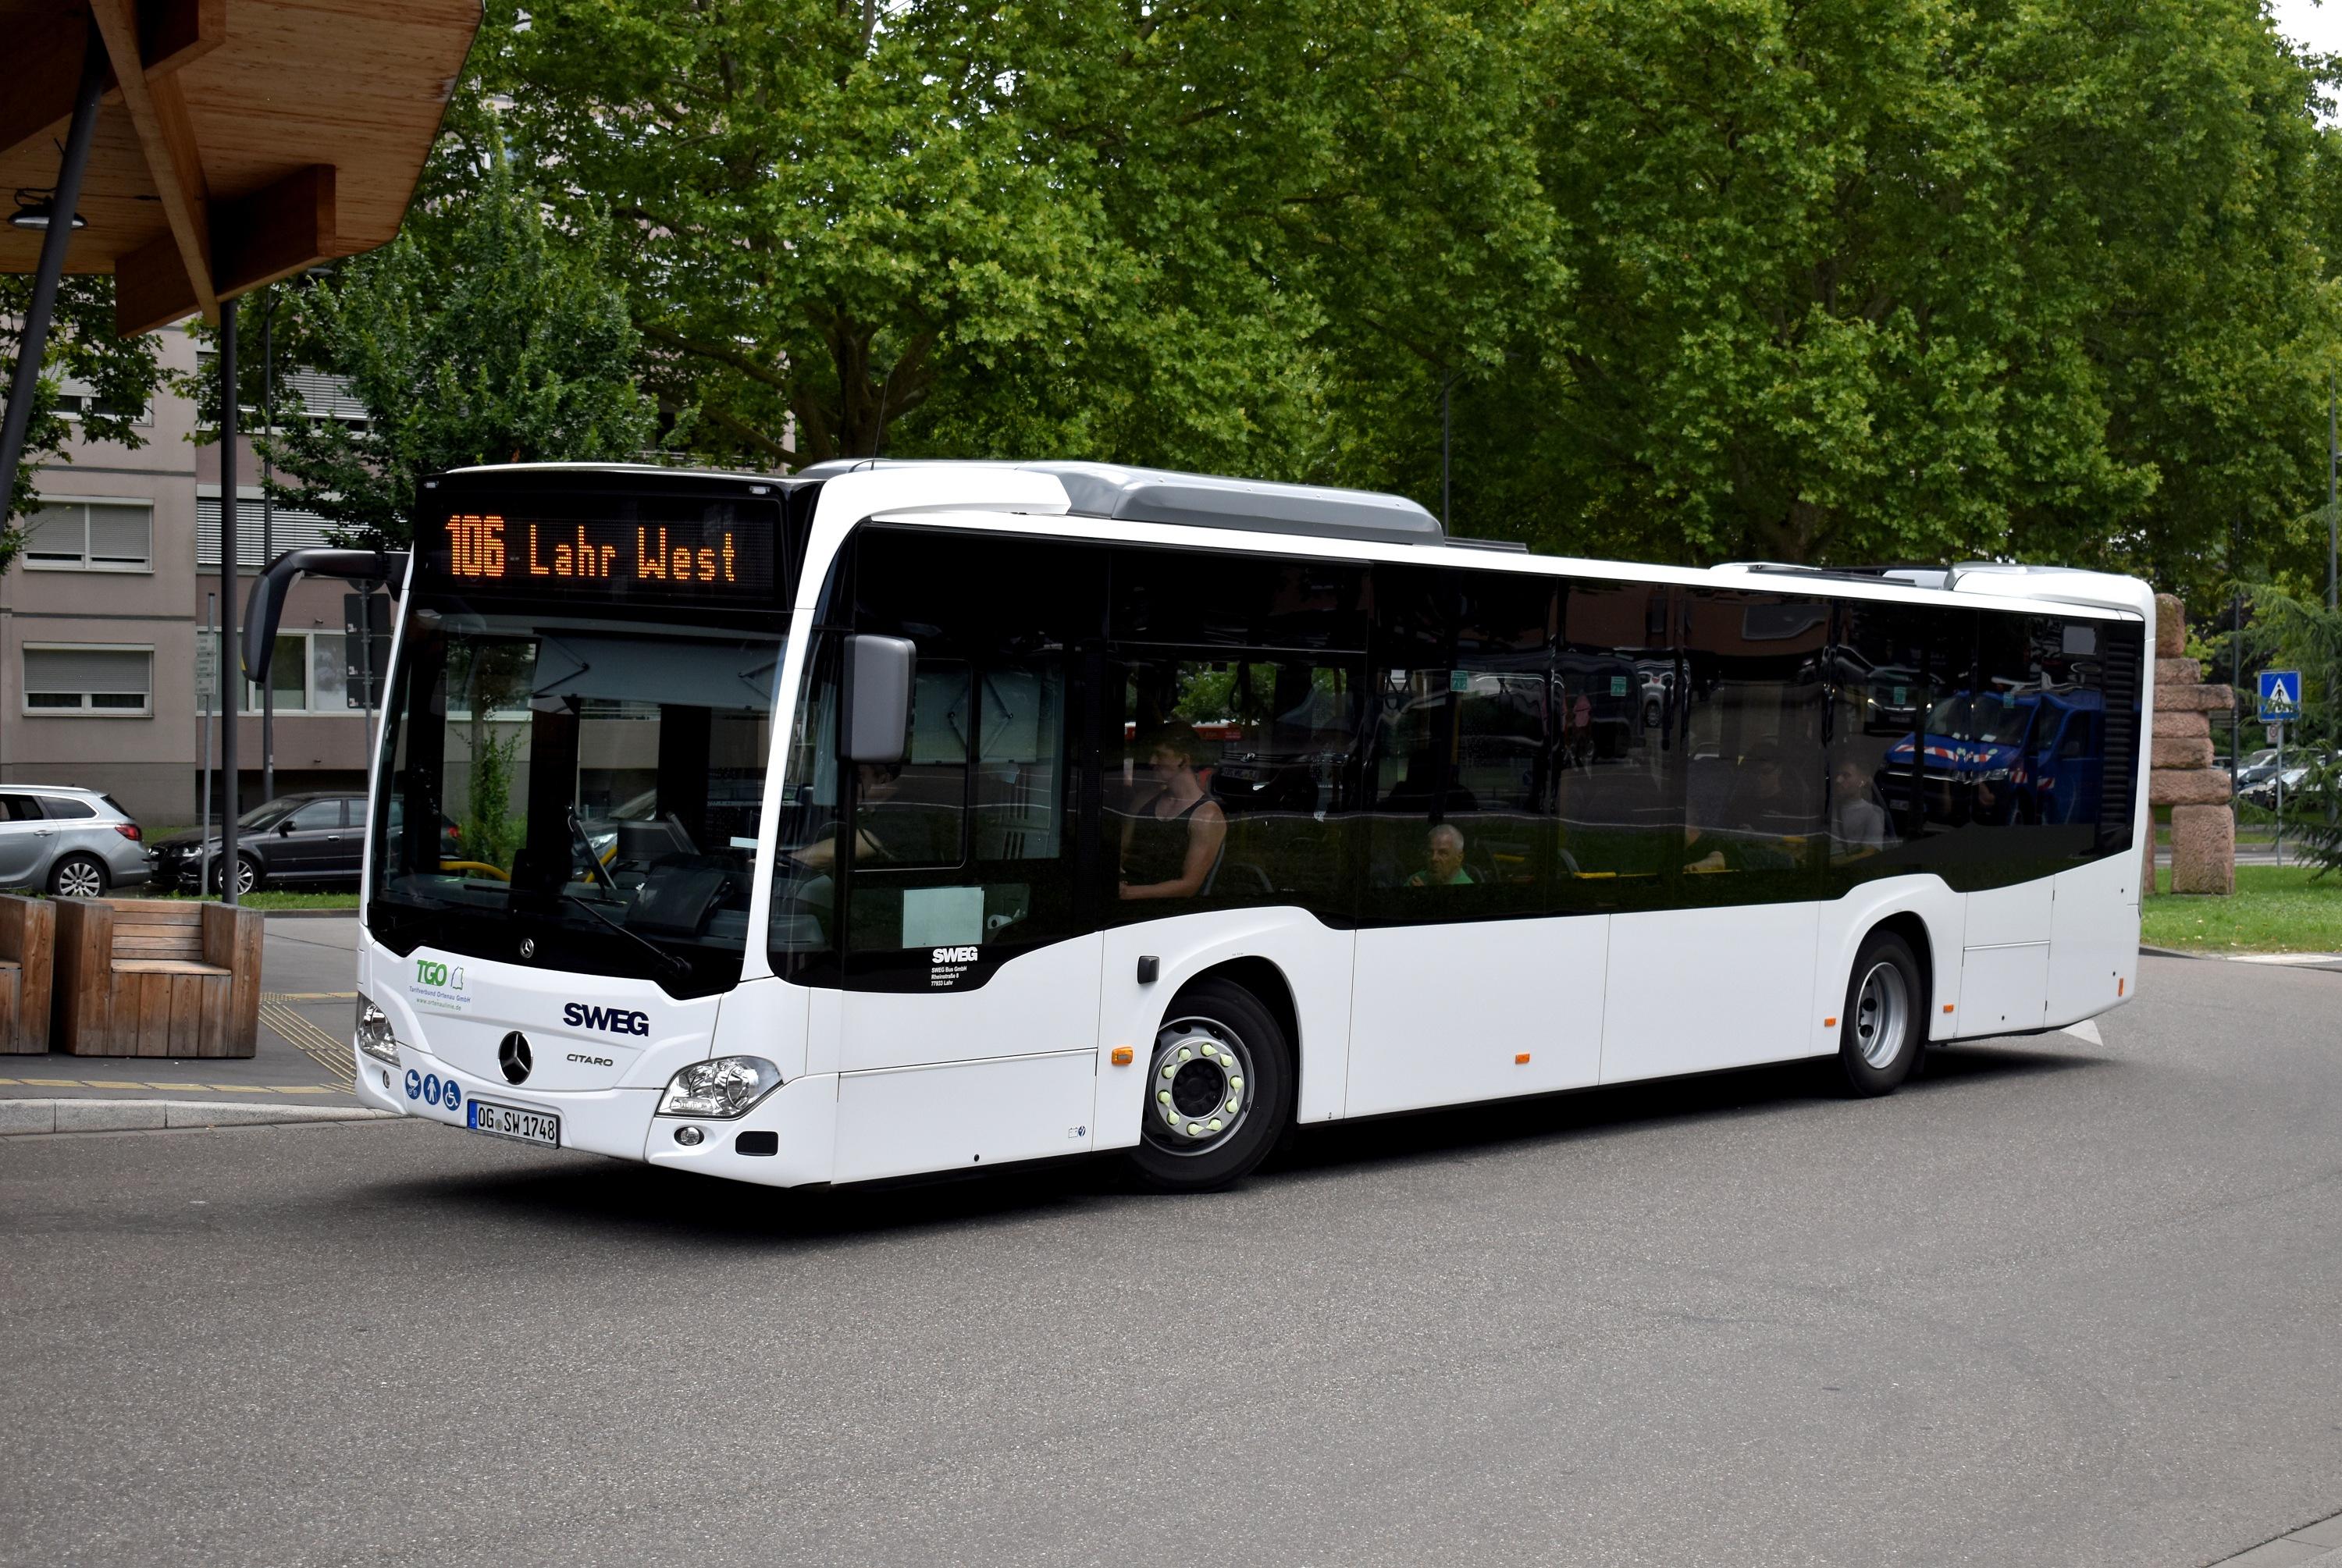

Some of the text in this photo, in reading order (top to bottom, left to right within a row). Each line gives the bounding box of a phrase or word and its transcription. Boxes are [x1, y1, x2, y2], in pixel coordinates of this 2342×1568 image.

[446, 515, 735, 581] 106 Lahr West
[932, 946, 978, 963] SWEG
[417, 959, 447, 987] TGO
[409, 986, 436, 996] Tarifverbund
[437, 991, 455, 1000] Ortenau
[563, 1002, 650, 1036] SWEG
[567, 1054, 614, 1067] CITARO
[478, 1107, 494, 1129] OG
[504, 1111, 520, 1134] SW
[523, 1115, 555, 1140] 1748
